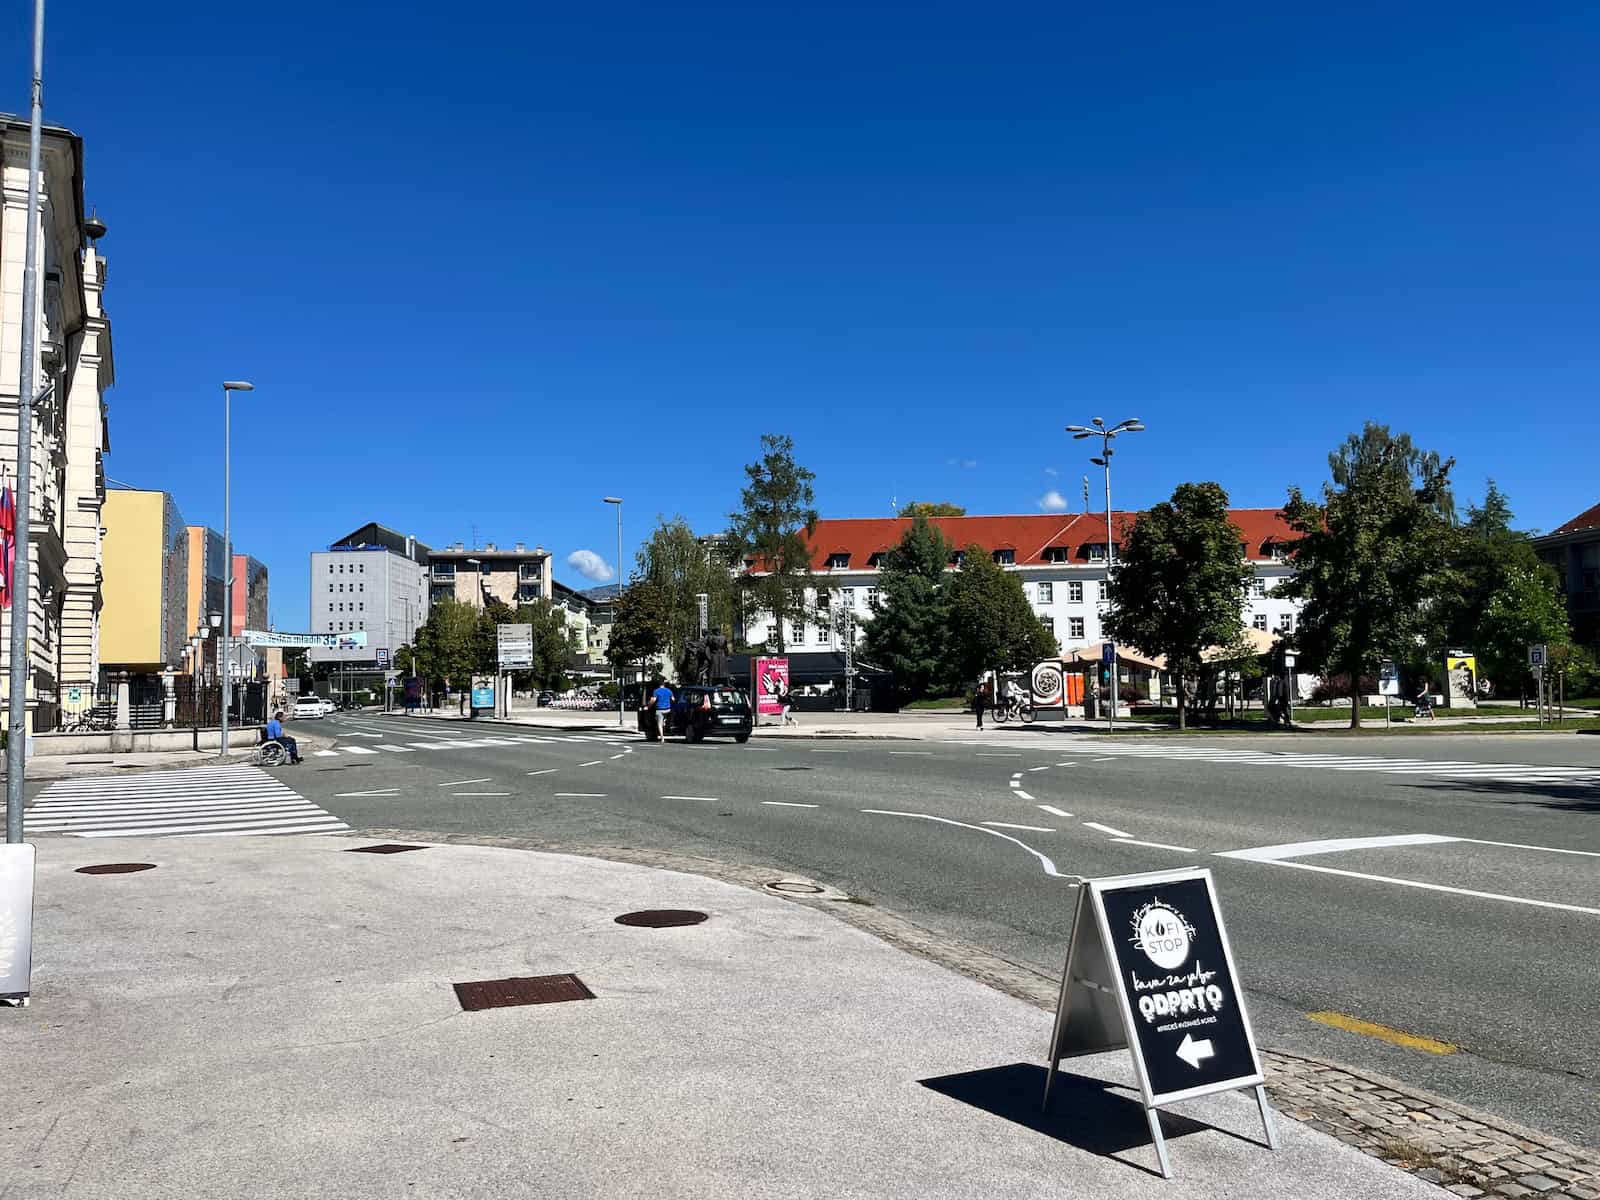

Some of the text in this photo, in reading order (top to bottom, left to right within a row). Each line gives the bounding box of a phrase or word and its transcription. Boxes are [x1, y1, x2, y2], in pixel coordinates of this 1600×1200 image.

[1149, 938, 1183, 954] STOP
[1131, 970, 1166, 991] kava
[1166, 975, 1186, 986] za
[1138, 984, 1223, 1023] ODPRTO
